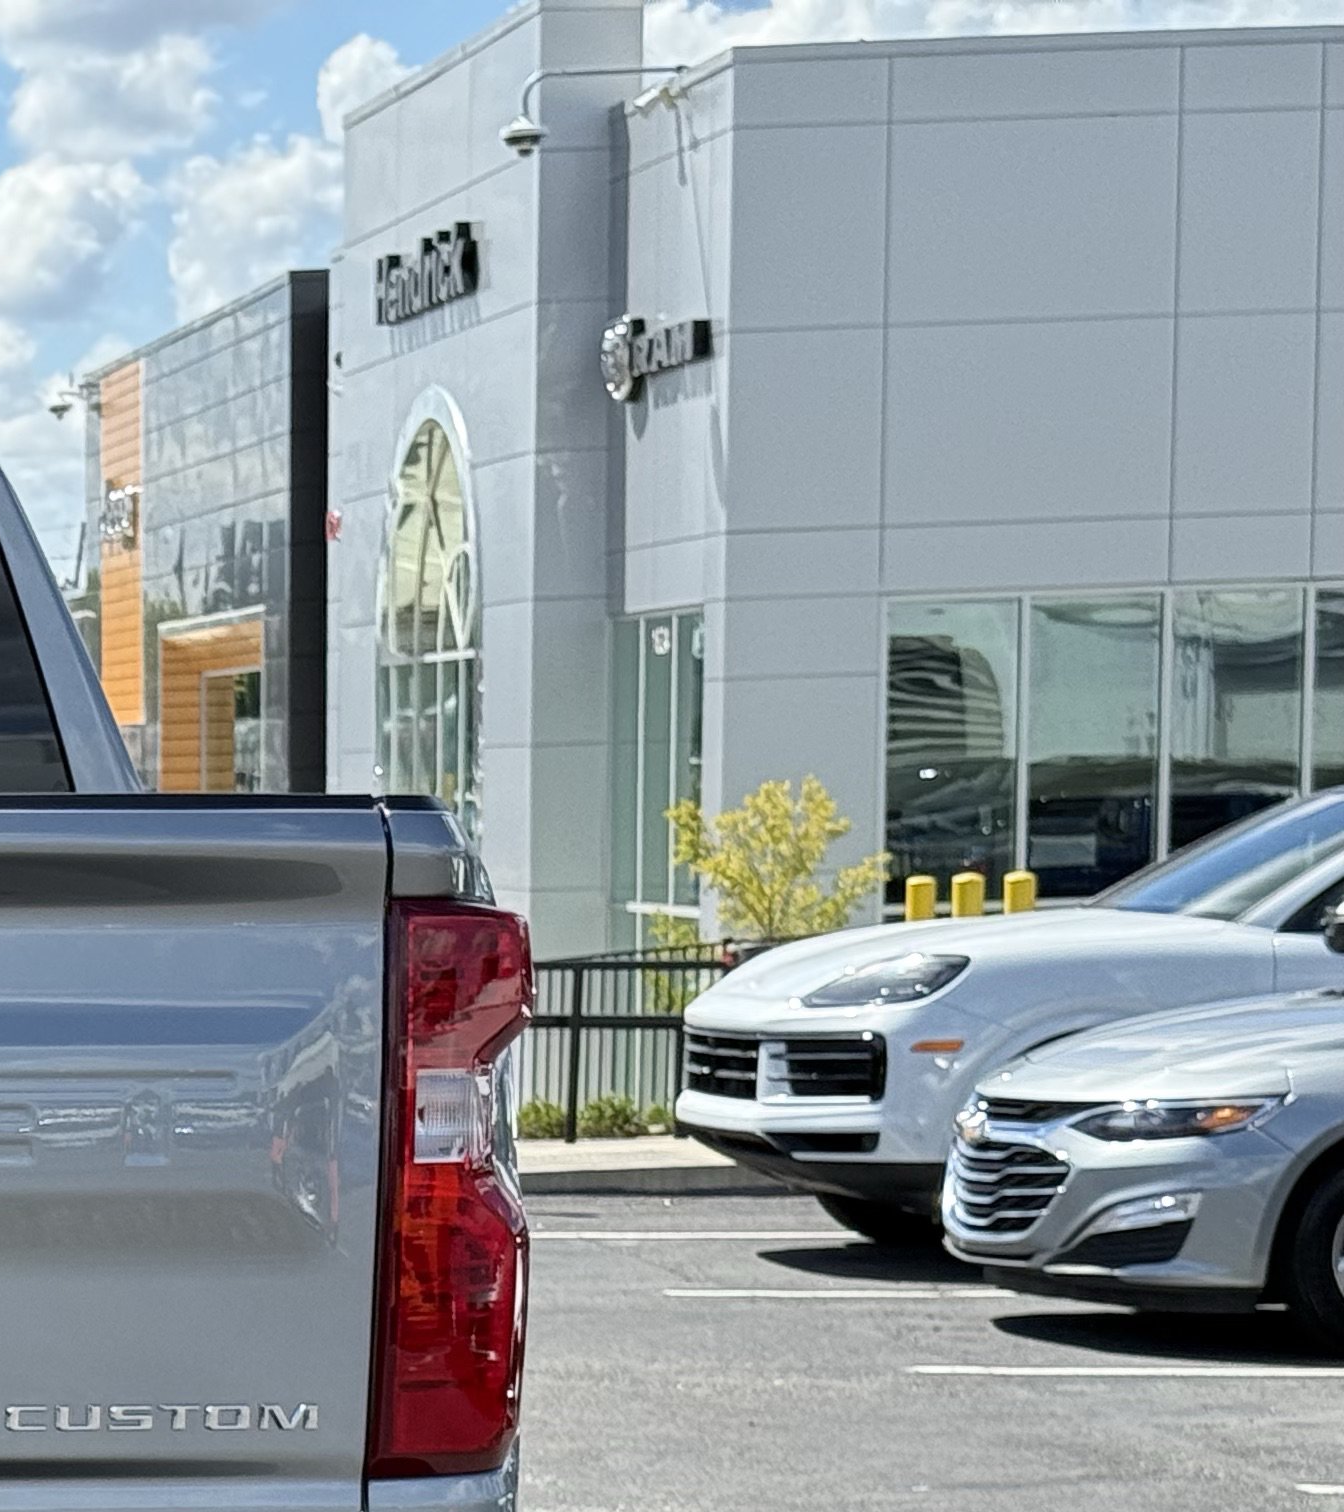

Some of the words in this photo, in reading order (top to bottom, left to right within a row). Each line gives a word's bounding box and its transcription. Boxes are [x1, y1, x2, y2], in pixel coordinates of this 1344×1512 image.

[375, 222, 479, 325] Hendrick
[631, 319, 713, 378] RAM
[5, 1403, 320, 1431] CUSTOM
